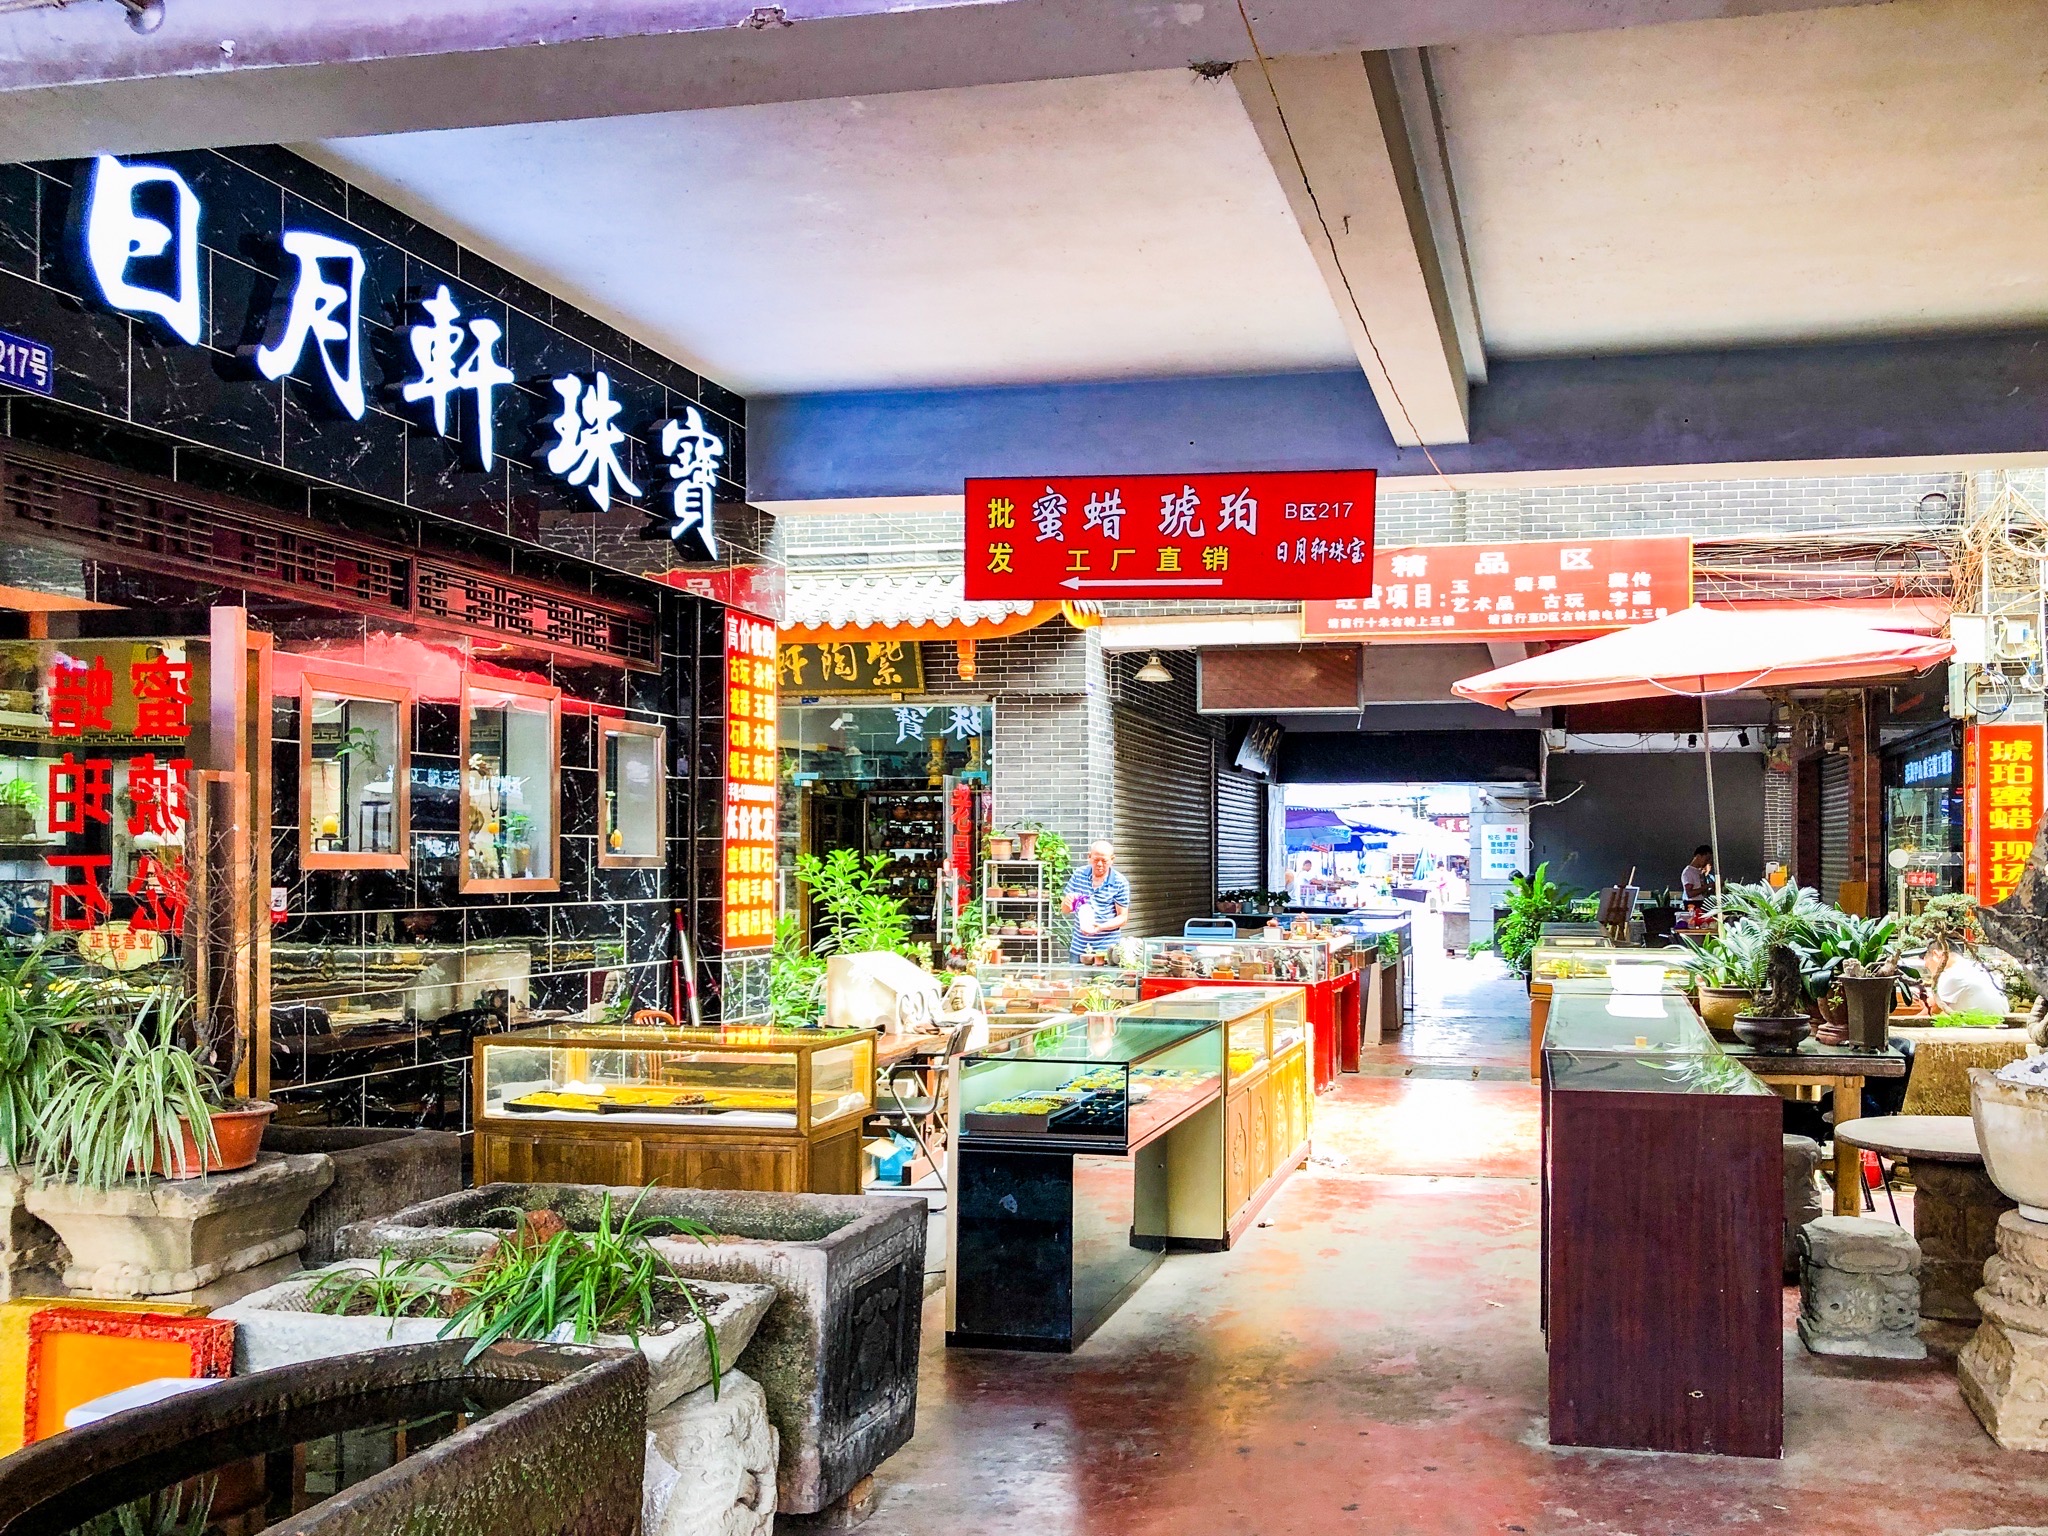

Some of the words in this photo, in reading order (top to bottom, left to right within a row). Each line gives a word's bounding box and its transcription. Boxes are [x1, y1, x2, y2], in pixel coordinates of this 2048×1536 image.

[86, 154, 725, 561] 日月軒珠寶
[1031, 485, 1126, 542] 蜜蜡
[1157, 484, 1258, 539] 琥珀
[1285, 502, 1353, 521] B区217
[987, 498, 1014, 574] 批发
[1066, 546, 1228, 573] 工厂直销
[1276, 537, 1366, 565] 日月轩珠宝
[1391, 548, 1593, 577] 精品区
[1451, 596, 1514, 612] 艺术品
[1542, 593, 1584, 609] 古玩
[730, 656, 750, 686] 古玩
[1989, 740, 2033, 829] 琥珀蜜蜡
[89, 932, 154, 950] 正在营业
